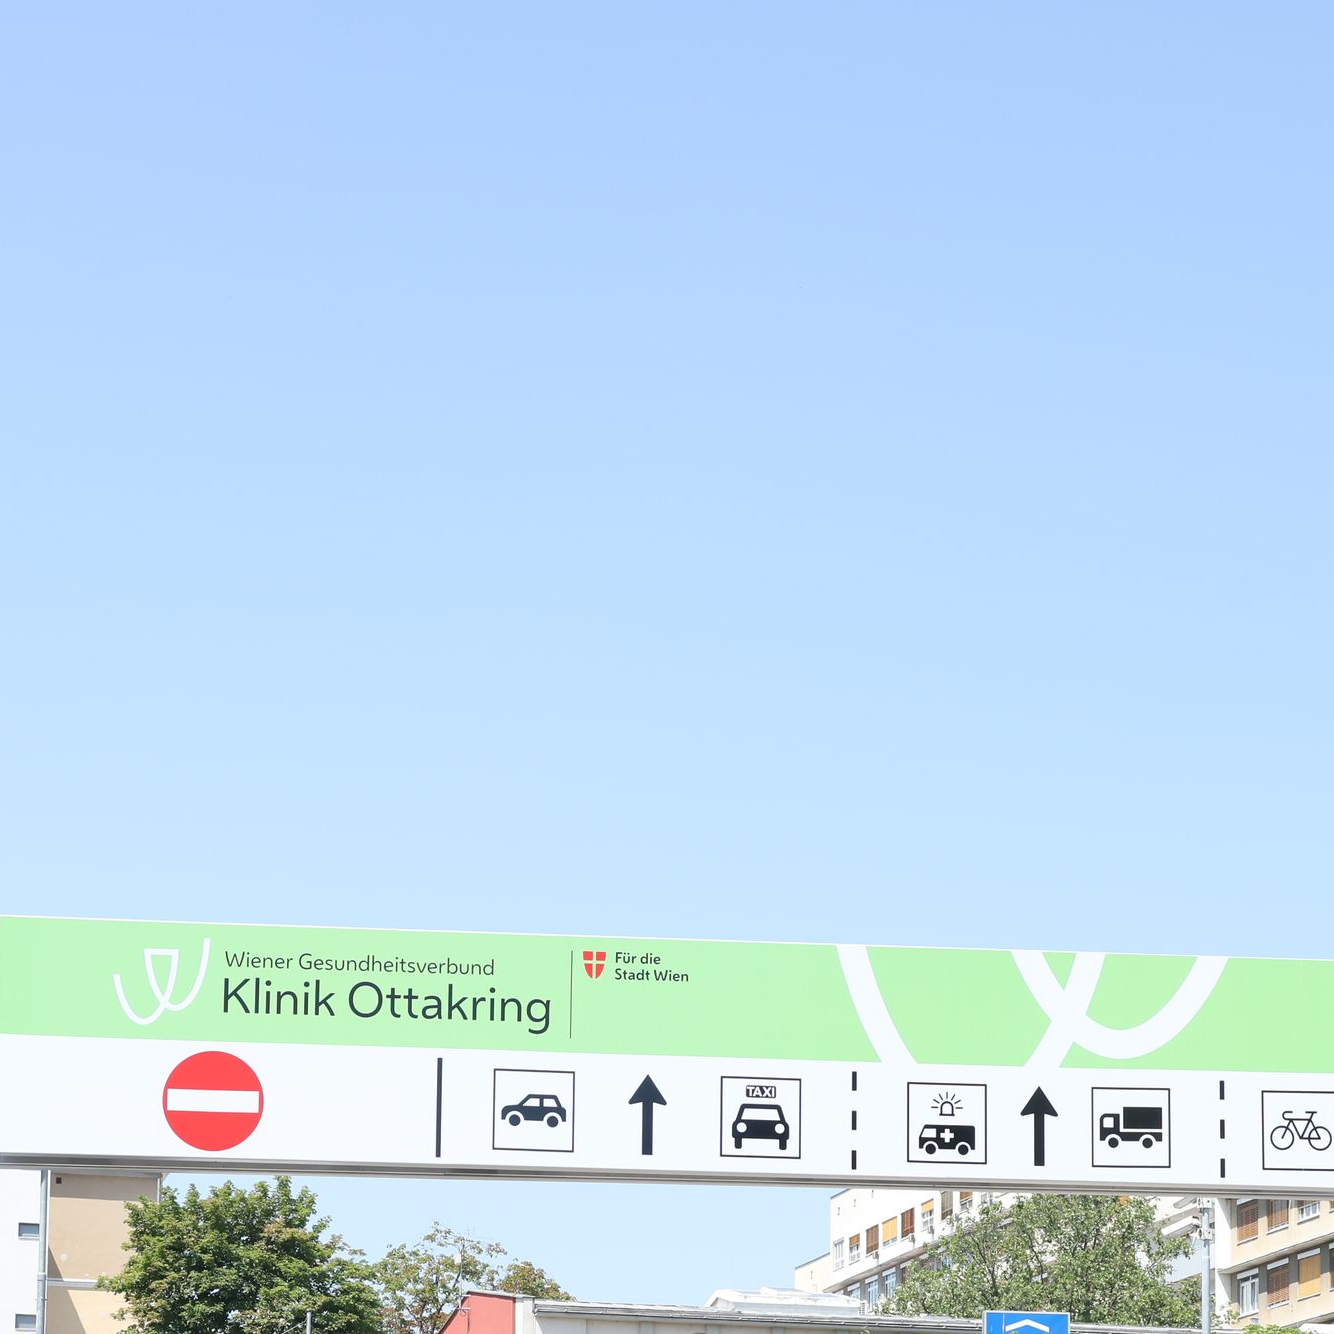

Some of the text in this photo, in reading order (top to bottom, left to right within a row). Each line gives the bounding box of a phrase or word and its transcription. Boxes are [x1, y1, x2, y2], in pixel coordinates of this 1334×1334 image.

[224, 950, 495, 976] Wiener Gesundheitsverbund
[614, 951, 662, 966] Für die
[614, 968, 690, 982] Stadt Wien
[222, 977, 552, 1035] Klinik Ottakring
[746, 1086, 776, 1098] TAXI
